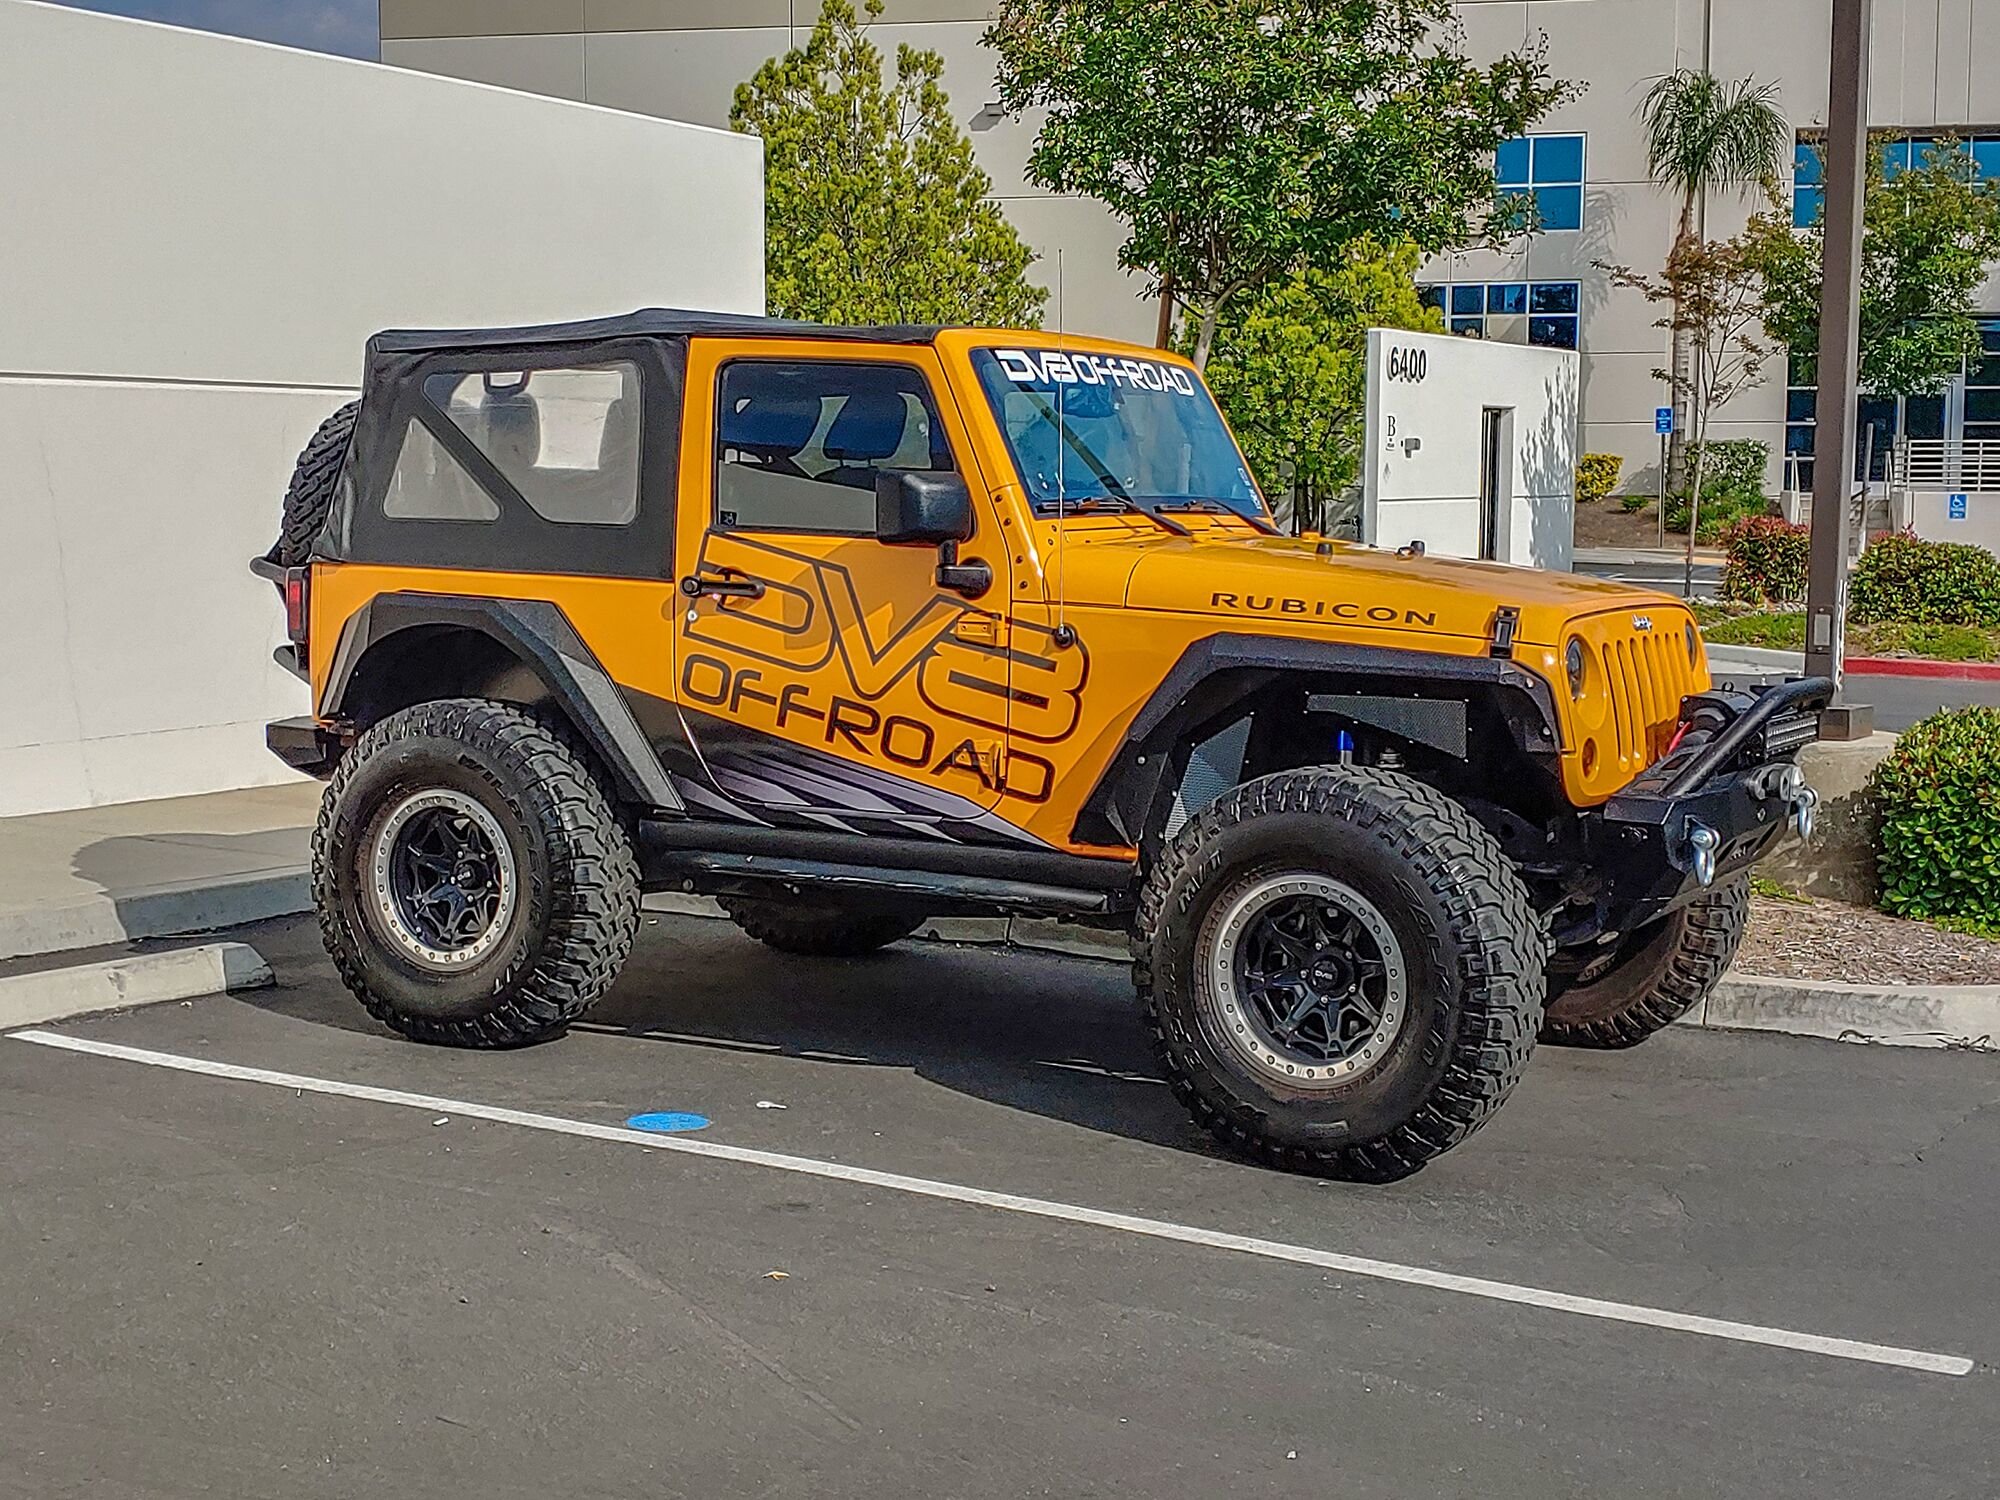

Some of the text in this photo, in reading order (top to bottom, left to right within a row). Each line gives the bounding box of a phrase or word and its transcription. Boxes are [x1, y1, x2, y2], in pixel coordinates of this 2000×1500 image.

[1389, 346, 1427, 380] 6400
[1210, 593, 1437, 626] RUBICON
[683, 528, 1090, 744] DV8
